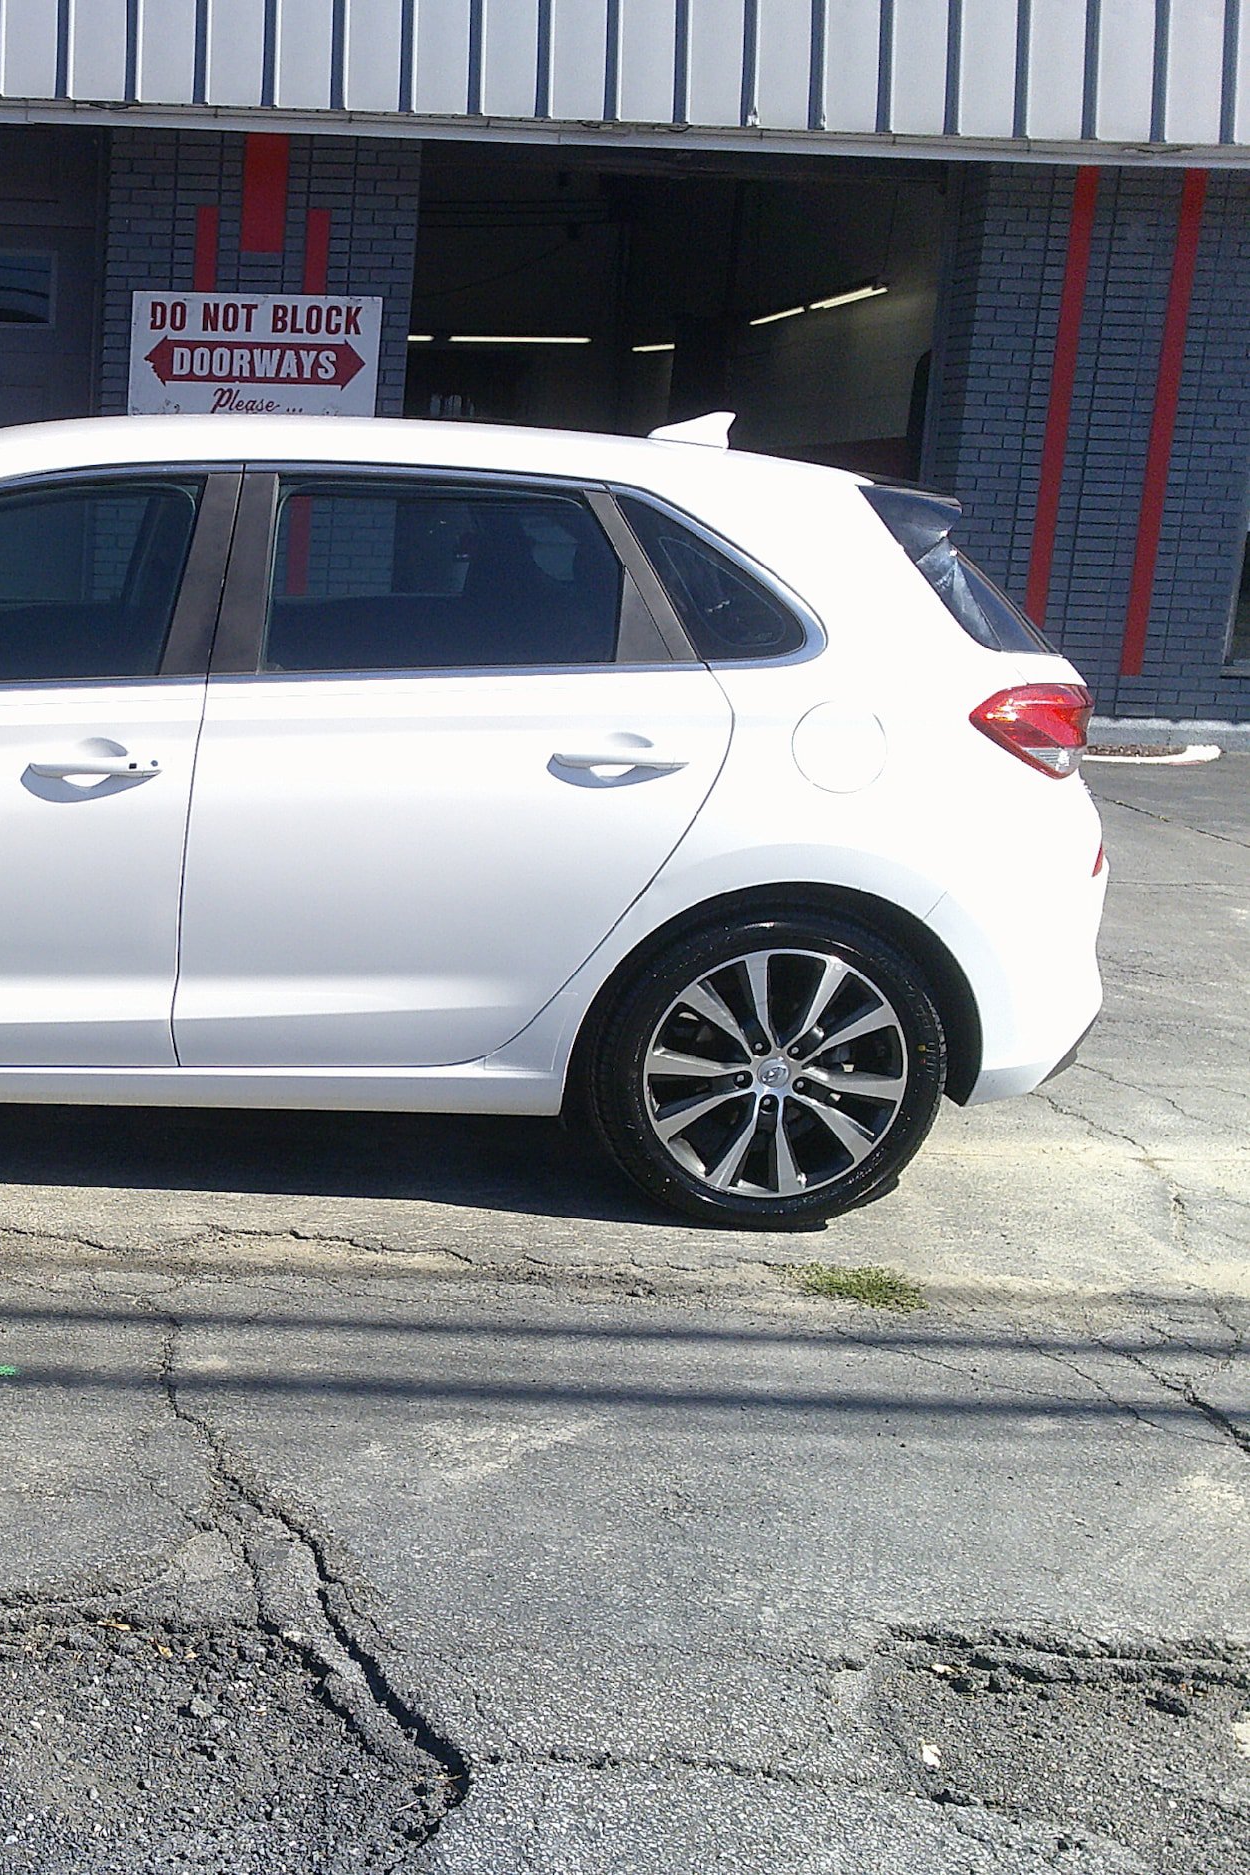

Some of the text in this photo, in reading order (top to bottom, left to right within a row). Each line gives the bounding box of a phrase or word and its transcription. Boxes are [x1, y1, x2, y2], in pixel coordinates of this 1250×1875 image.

[150, 301, 363, 335] DO NOT BLOCK
[172, 346, 338, 380] DOORWAYS
